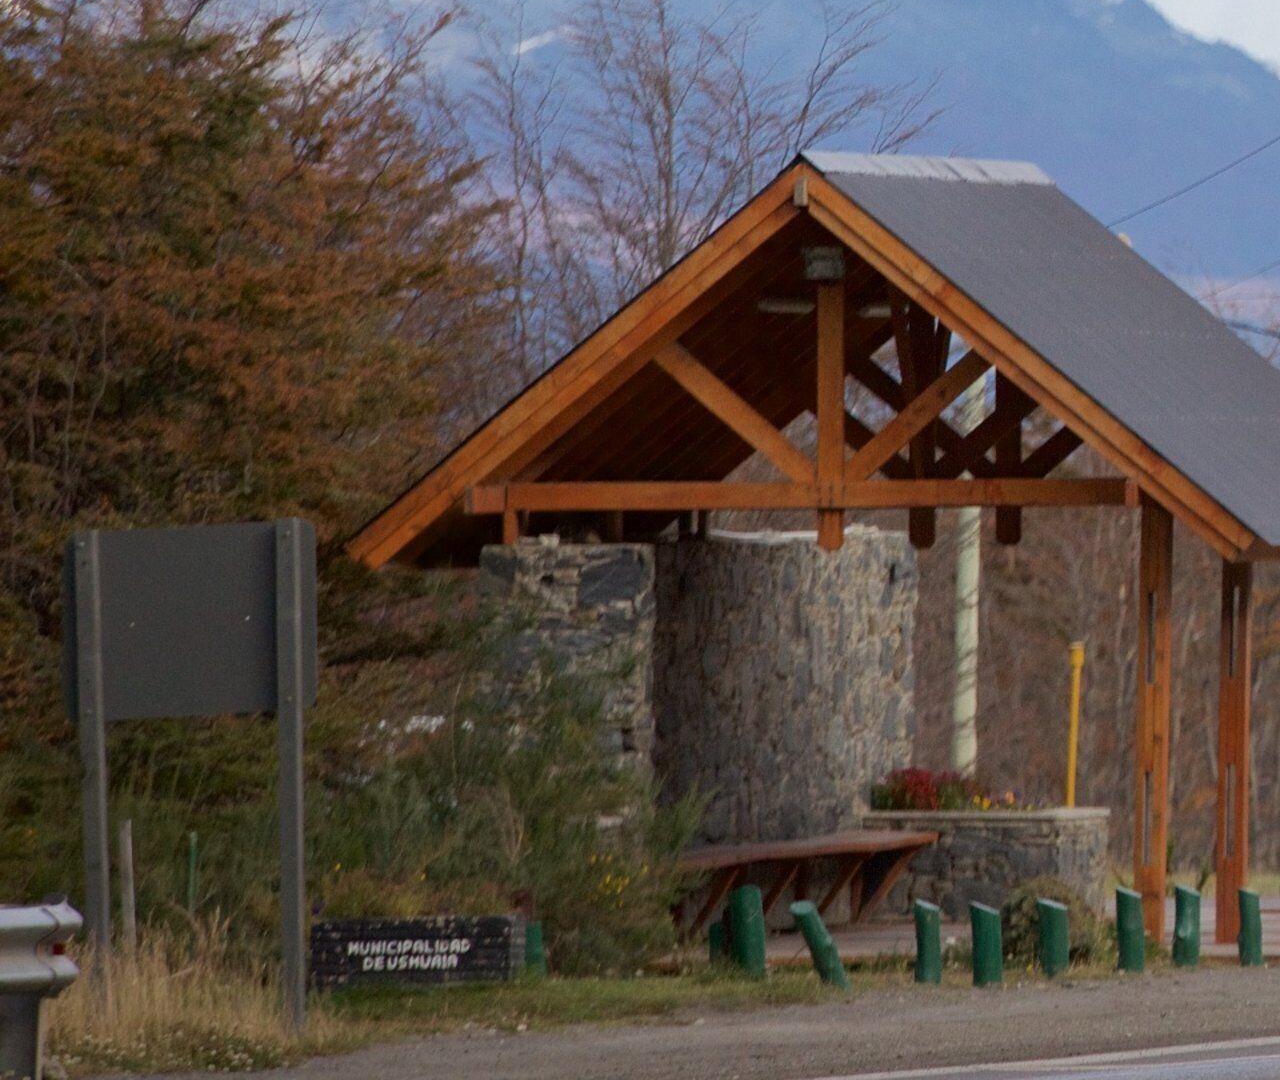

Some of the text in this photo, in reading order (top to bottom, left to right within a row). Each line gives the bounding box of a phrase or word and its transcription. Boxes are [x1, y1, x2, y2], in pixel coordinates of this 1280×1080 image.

[347, 938, 471, 957] MUNICIPALIDAD
[362, 953, 459, 971] DE USHUAIA
